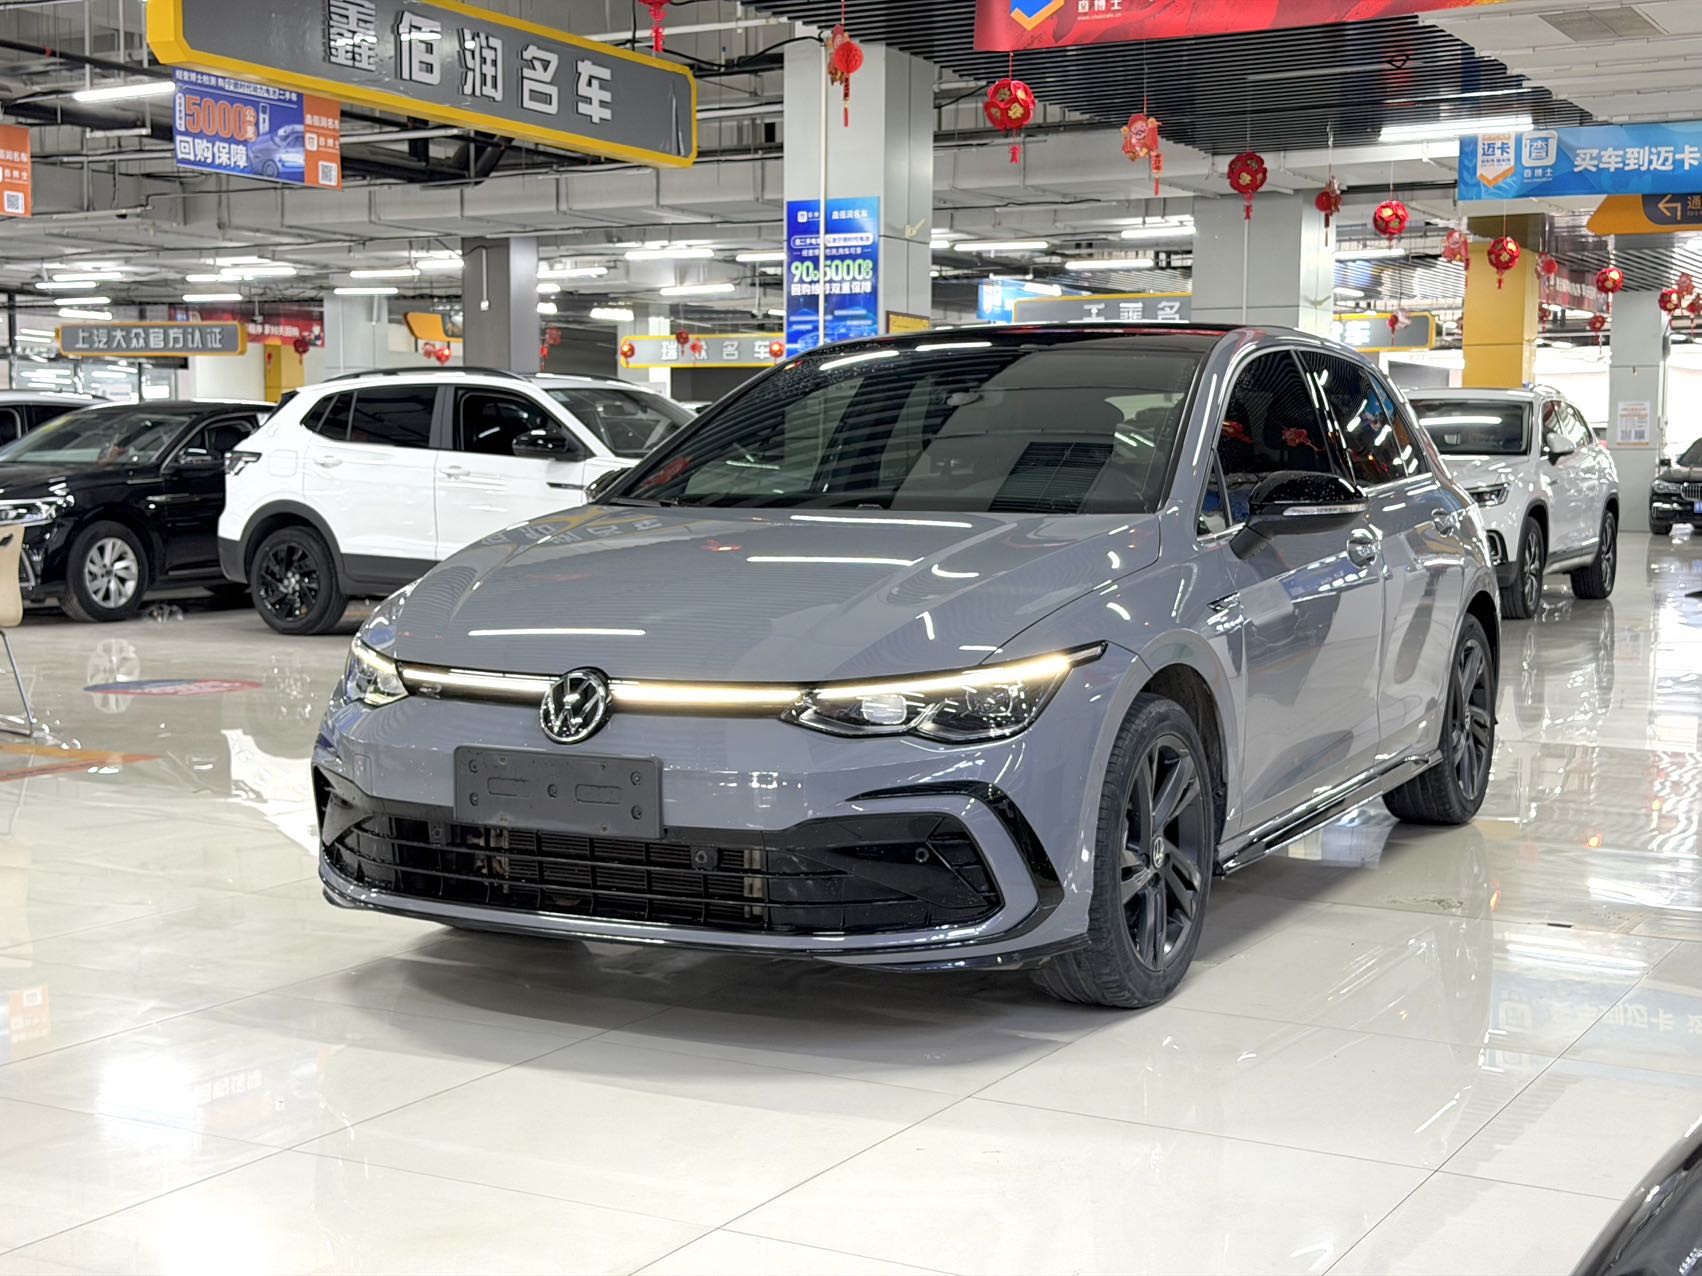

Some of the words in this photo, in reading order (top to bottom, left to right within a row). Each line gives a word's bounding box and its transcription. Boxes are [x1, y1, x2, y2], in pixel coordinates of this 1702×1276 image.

[327, 0, 612, 124] 鑫佰润名车
[175, 134, 248, 169] 回购保障
[1482, 142, 1511, 157] 迈卡
[1573, 144, 1700, 173] 买车到迈卡
[74, 328, 223, 349] 上汽大众官方认证
